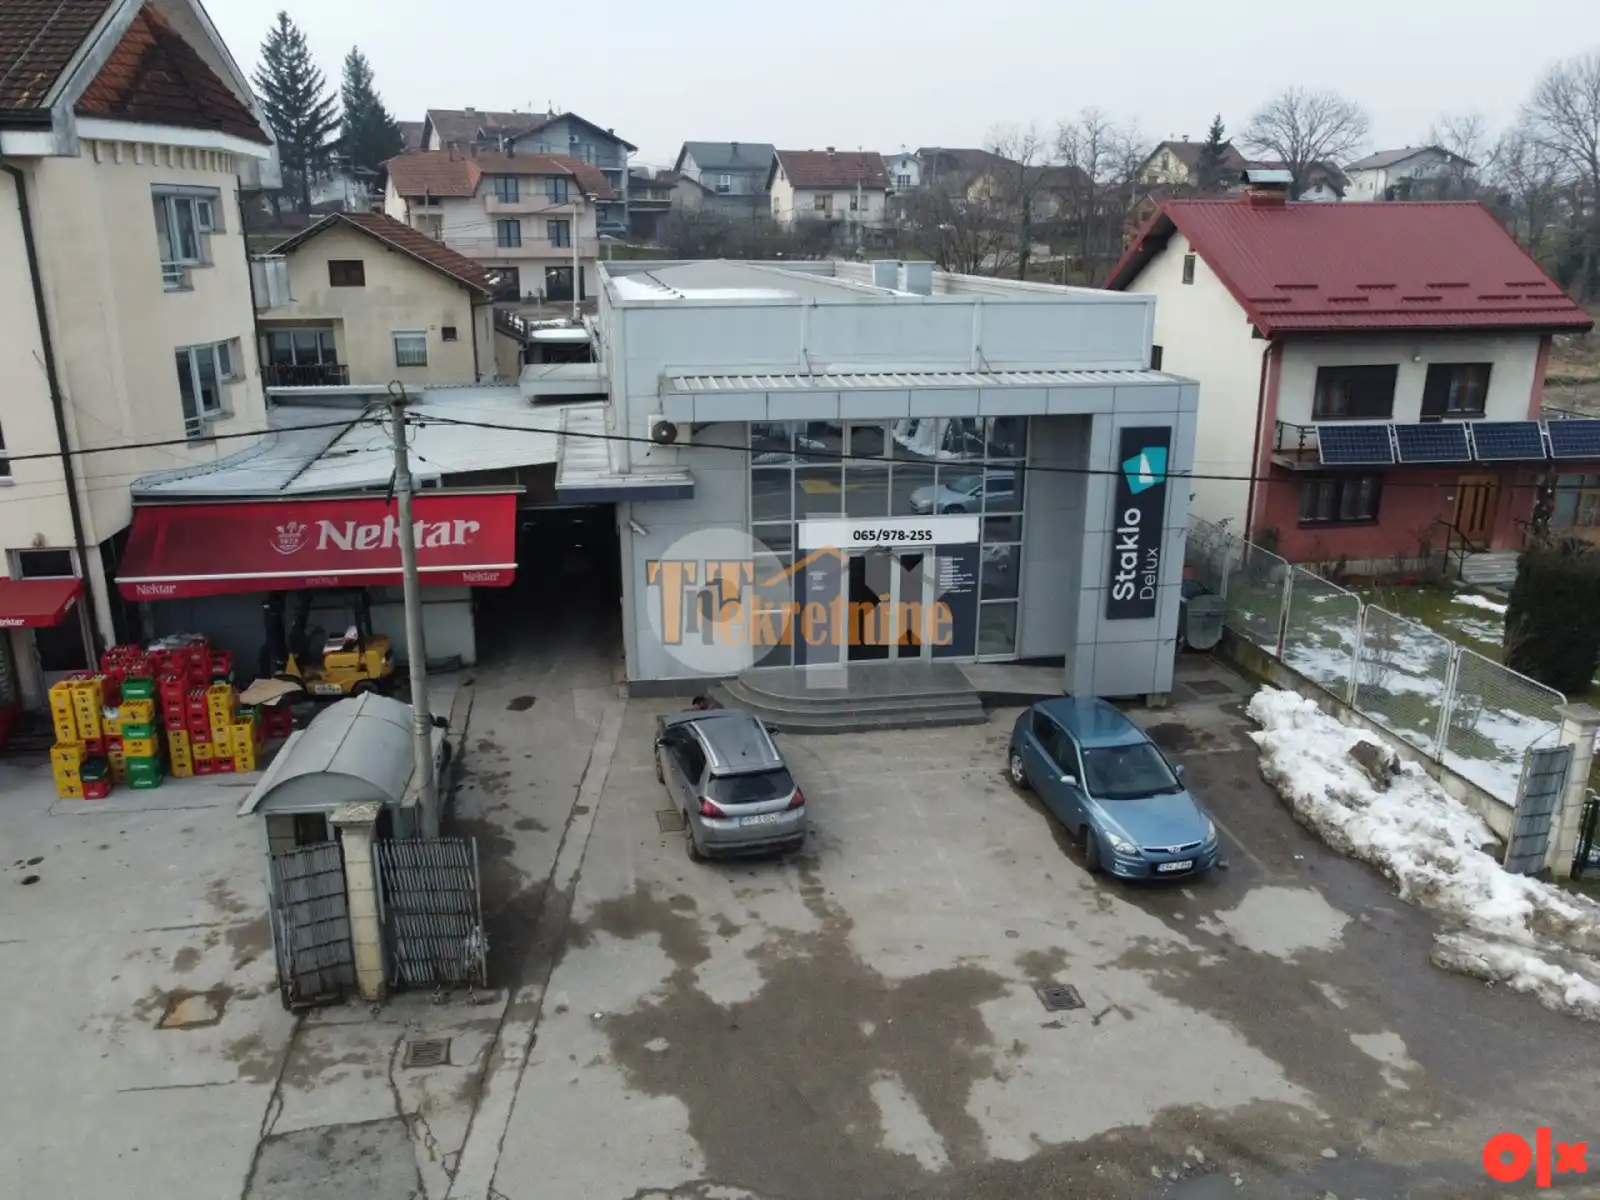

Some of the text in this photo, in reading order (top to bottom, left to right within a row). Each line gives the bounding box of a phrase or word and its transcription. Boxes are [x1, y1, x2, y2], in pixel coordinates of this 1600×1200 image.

[315, 514, 481, 550] Nektar
[853, 528, 933, 541] 065/978-255
[1112, 508, 1141, 600] Staklo
[462, 571, 500, 582] Nektar
[1139, 547, 1159, 600] Delux
[135, 583, 177, 596] Nektar
[0, 616, 25, 627] ektar
